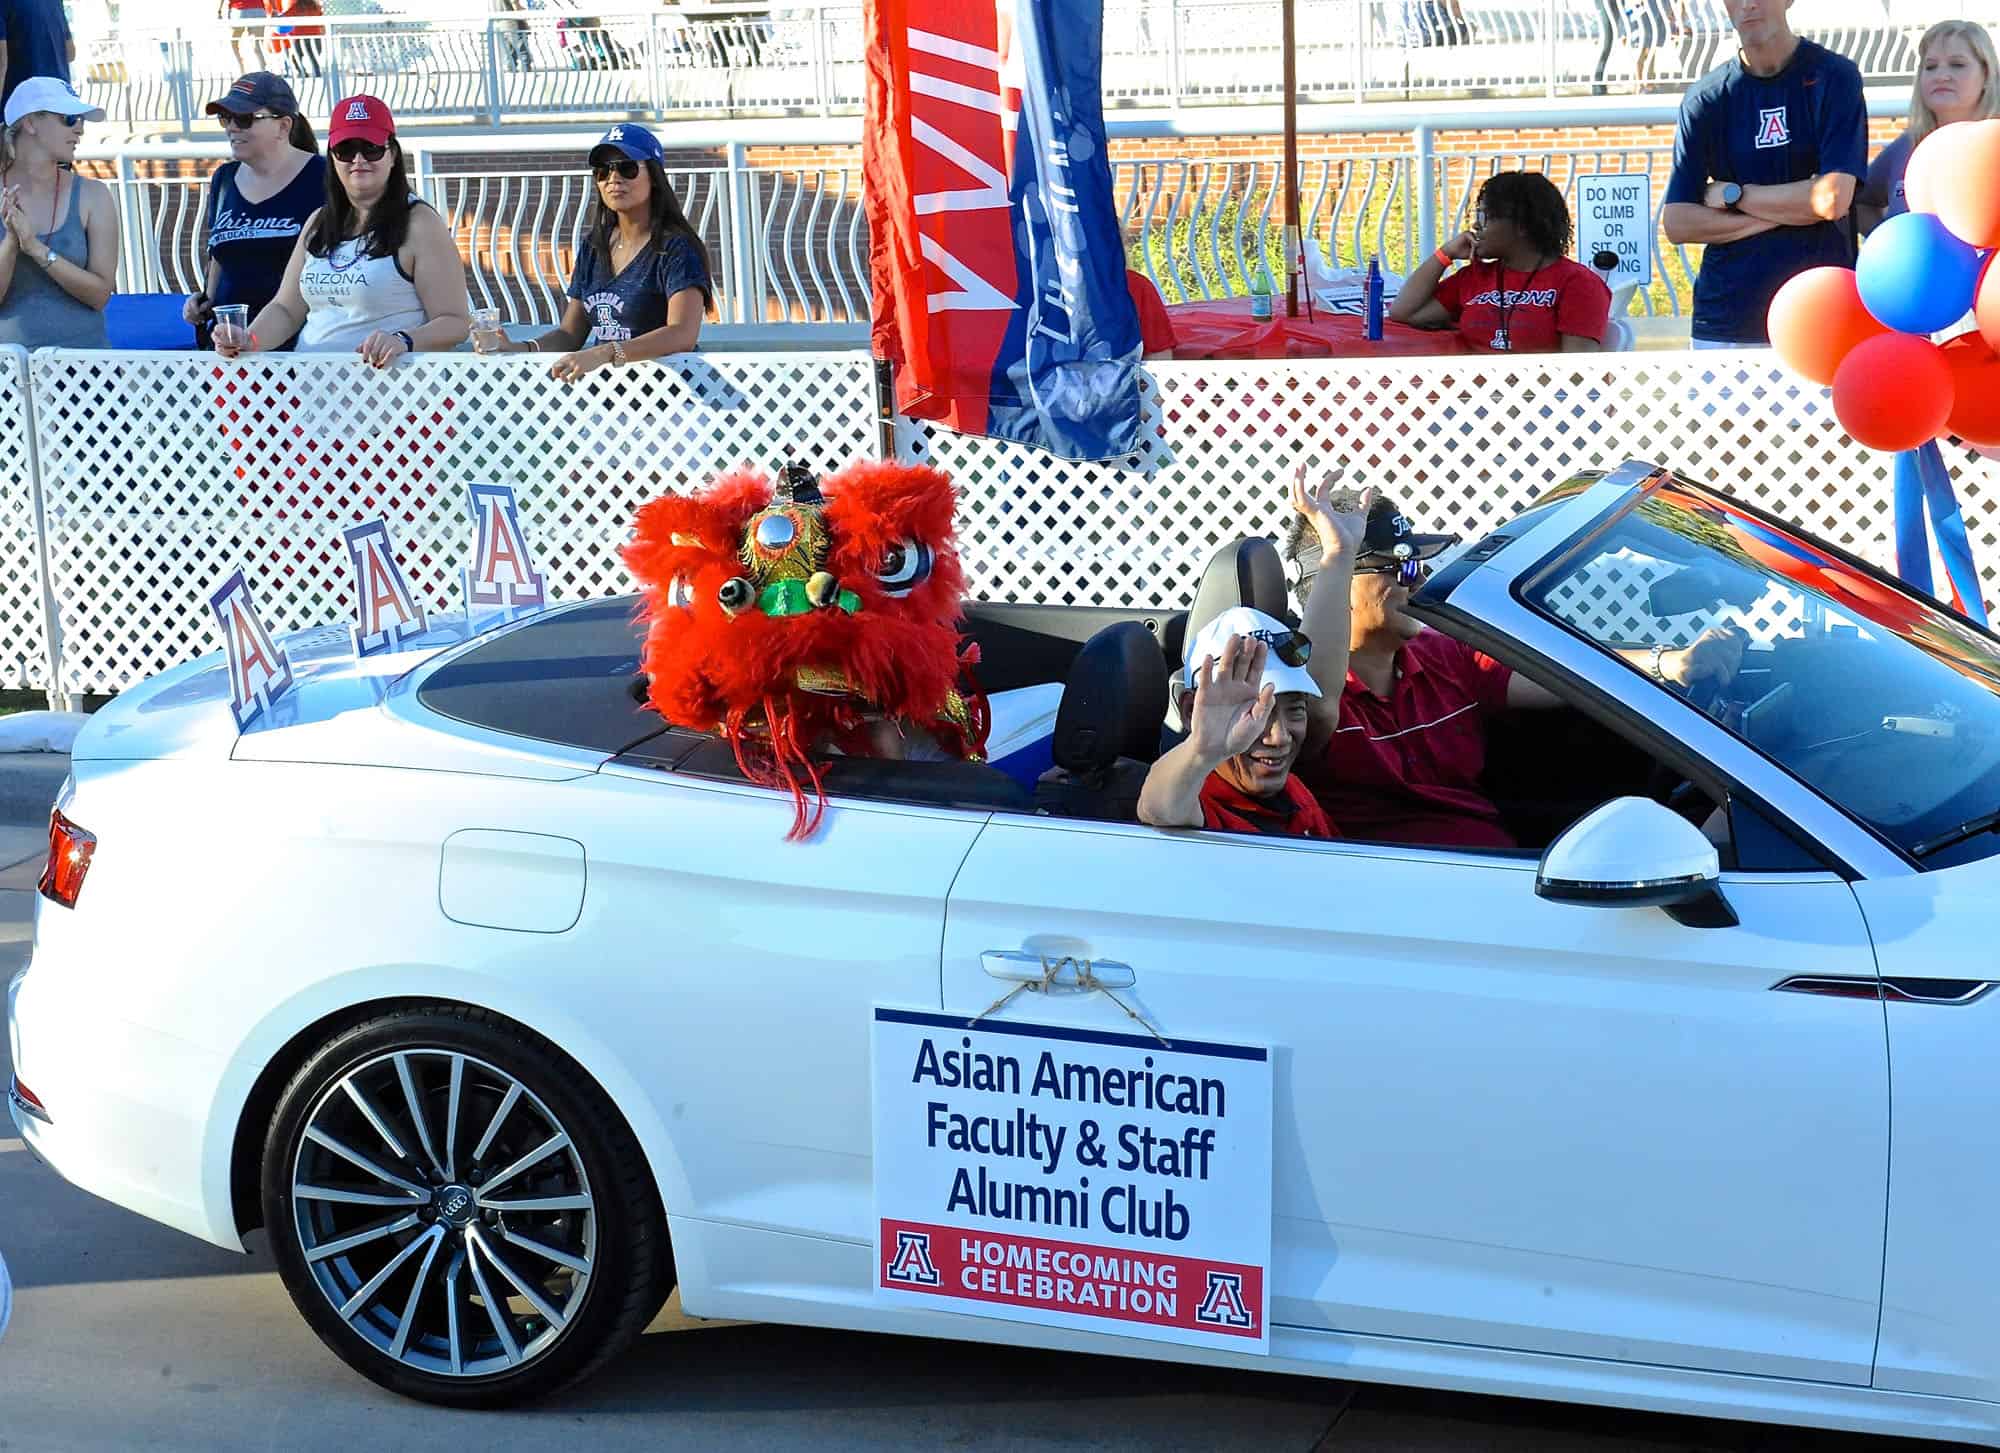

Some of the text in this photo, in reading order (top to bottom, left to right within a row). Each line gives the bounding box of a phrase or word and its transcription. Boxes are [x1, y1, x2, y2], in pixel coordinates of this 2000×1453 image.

[345, 101, 369, 121] A
[1755, 106, 1791, 149] A
[1586, 187, 1640, 201] DO NOT
[1592, 205, 1635, 219] CLIMB
[1604, 223, 1624, 237] OR
[1617, 241, 1638, 255] ON
[300, 272, 369, 287] RIZONA
[467, 483, 546, 609] A
[342, 519, 430, 658] A
[209, 569, 294, 737] A
[912, 1036, 1226, 1118] Asian American
[926, 1101, 1216, 1180] Faculty & Staff
[946, 1165, 1191, 1242] Alumni Club
[887, 1230, 941, 1287] A
[960, 1237, 1178, 1289] HOMECOMING
[960, 1265, 1178, 1318] CELEBRATION
[1196, 1270, 1253, 1330] A
